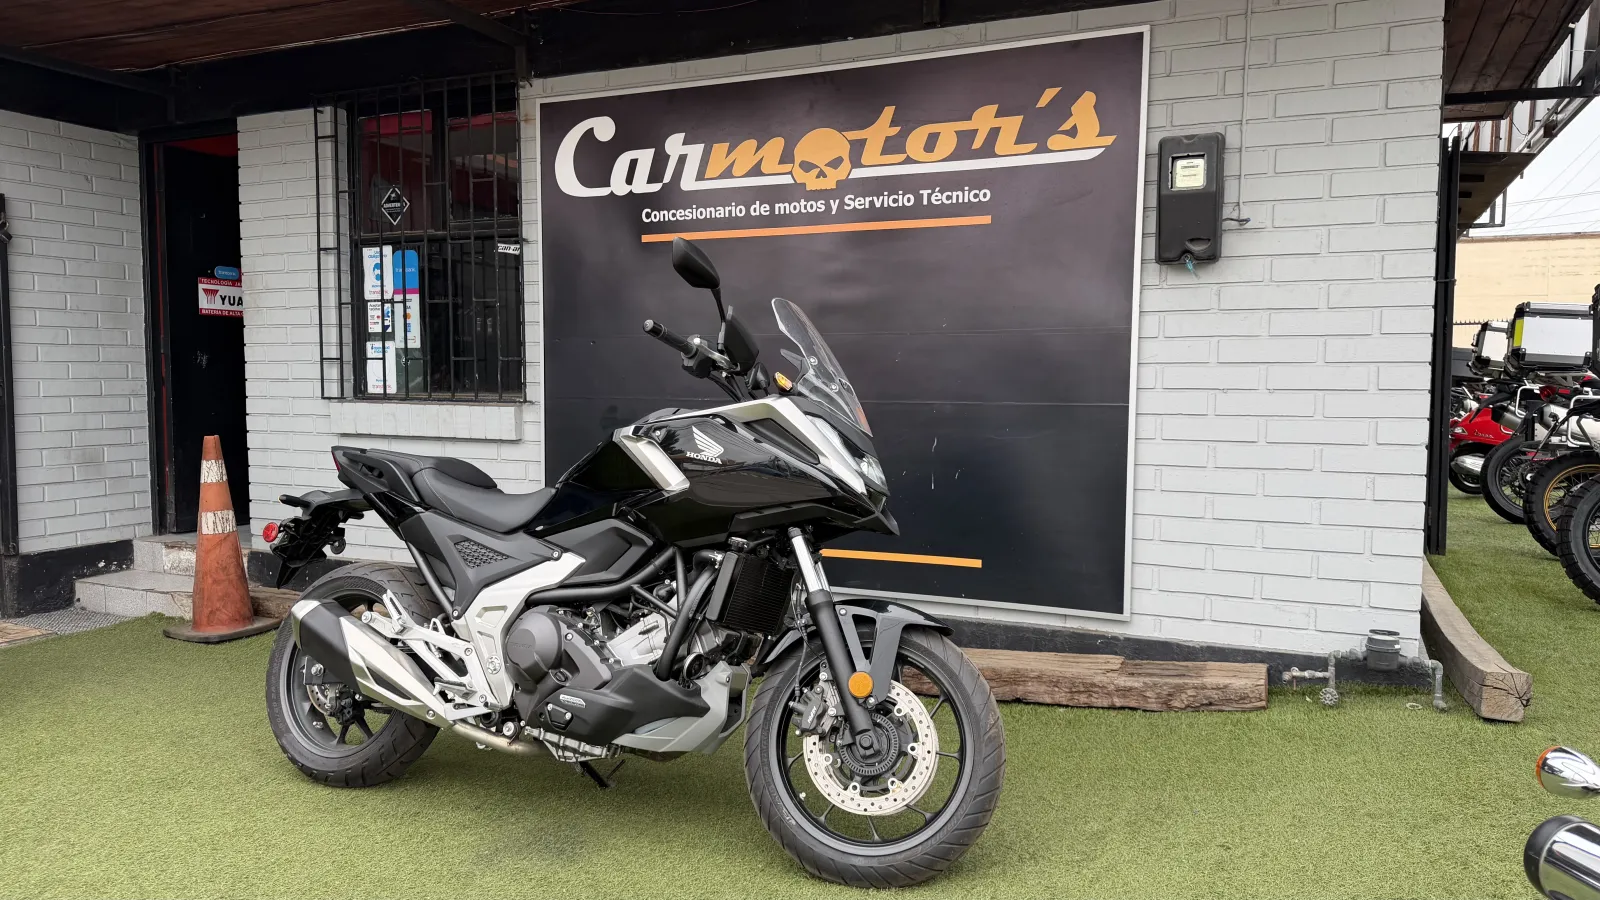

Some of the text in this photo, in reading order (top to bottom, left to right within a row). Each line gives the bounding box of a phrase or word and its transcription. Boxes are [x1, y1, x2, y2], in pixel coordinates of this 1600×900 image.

[641, 187, 991, 223] Concesionario de motos y Servicio Técnico
[686, 451, 723, 465] HONDA
